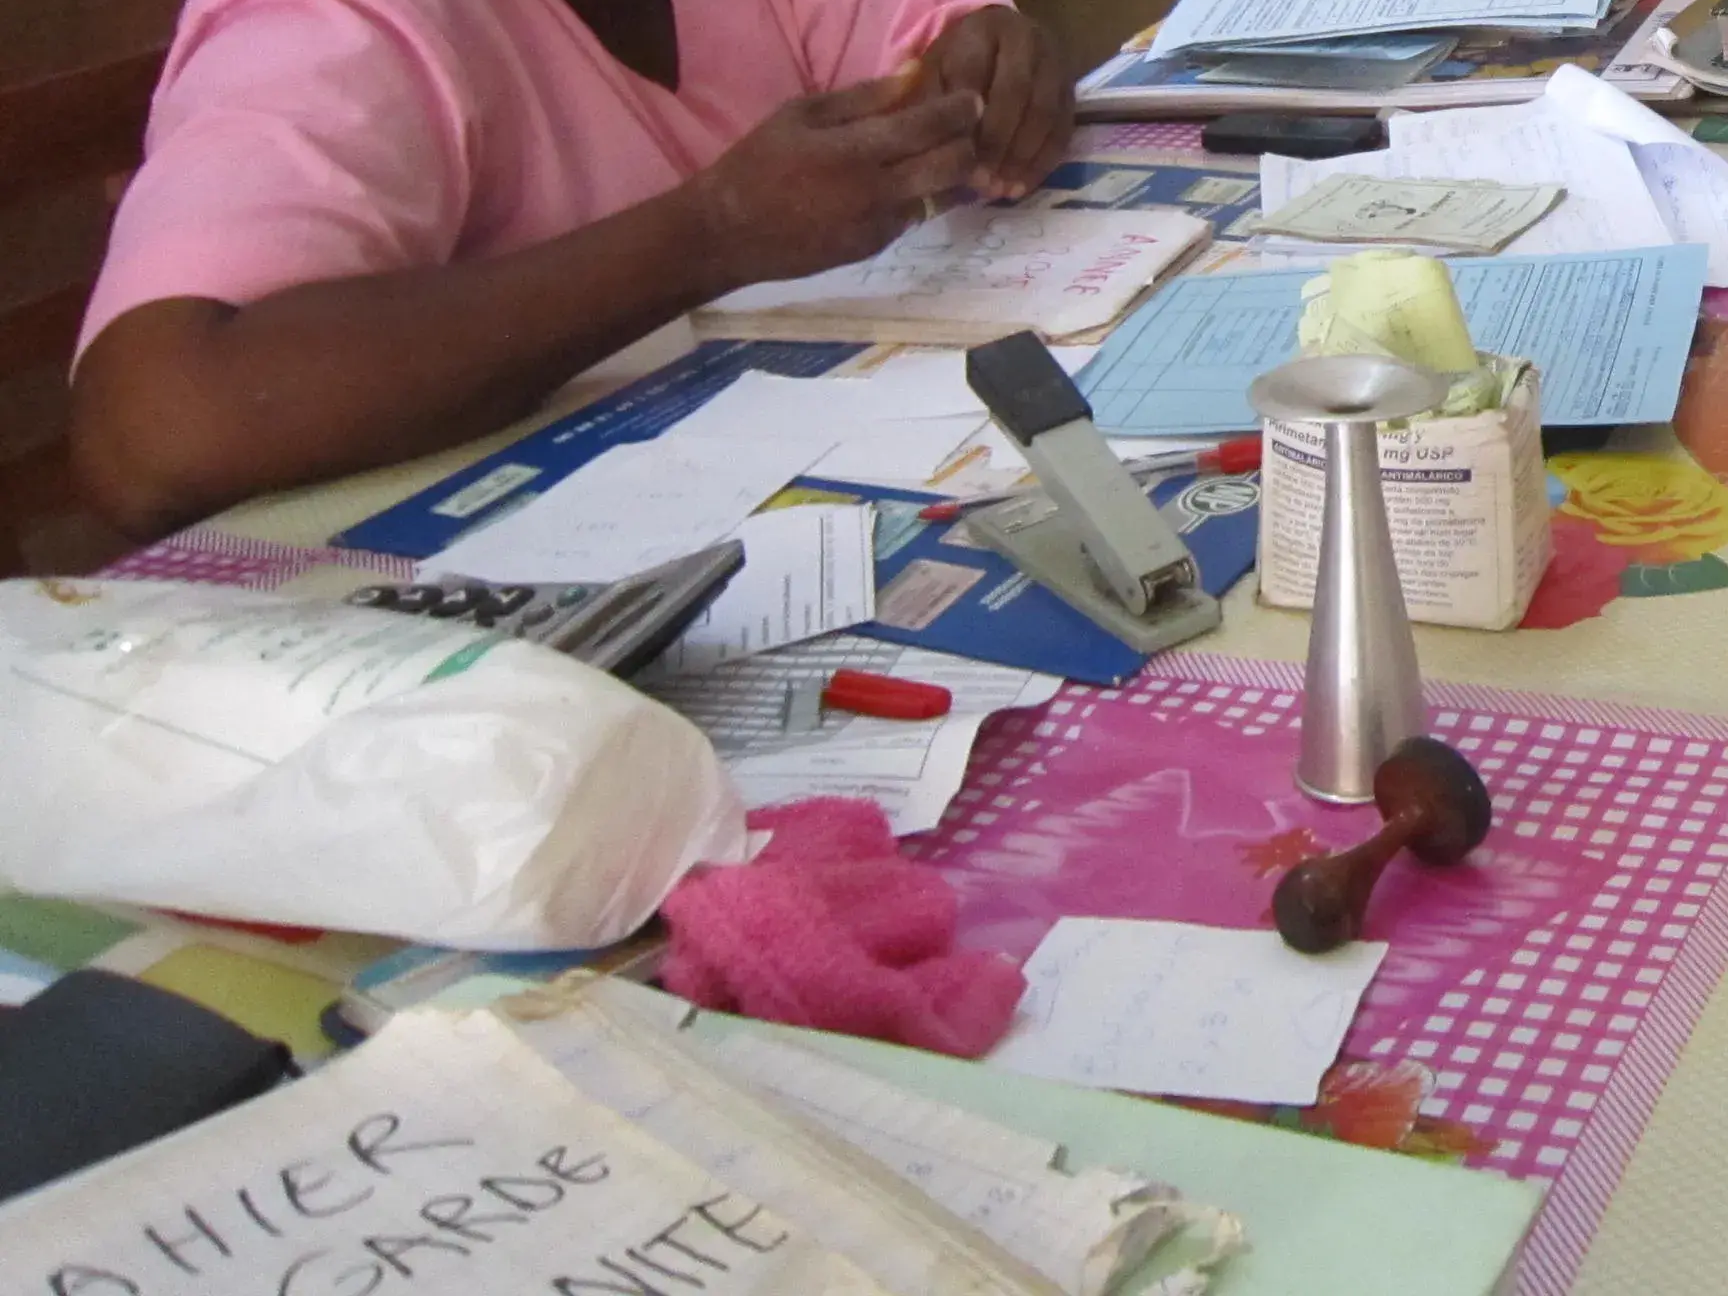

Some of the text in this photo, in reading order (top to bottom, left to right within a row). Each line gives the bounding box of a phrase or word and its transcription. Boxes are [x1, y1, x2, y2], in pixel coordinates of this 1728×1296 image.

[1383, 446, 1455, 464] mg USP
[280, 1145, 610, 1296] GARDE
